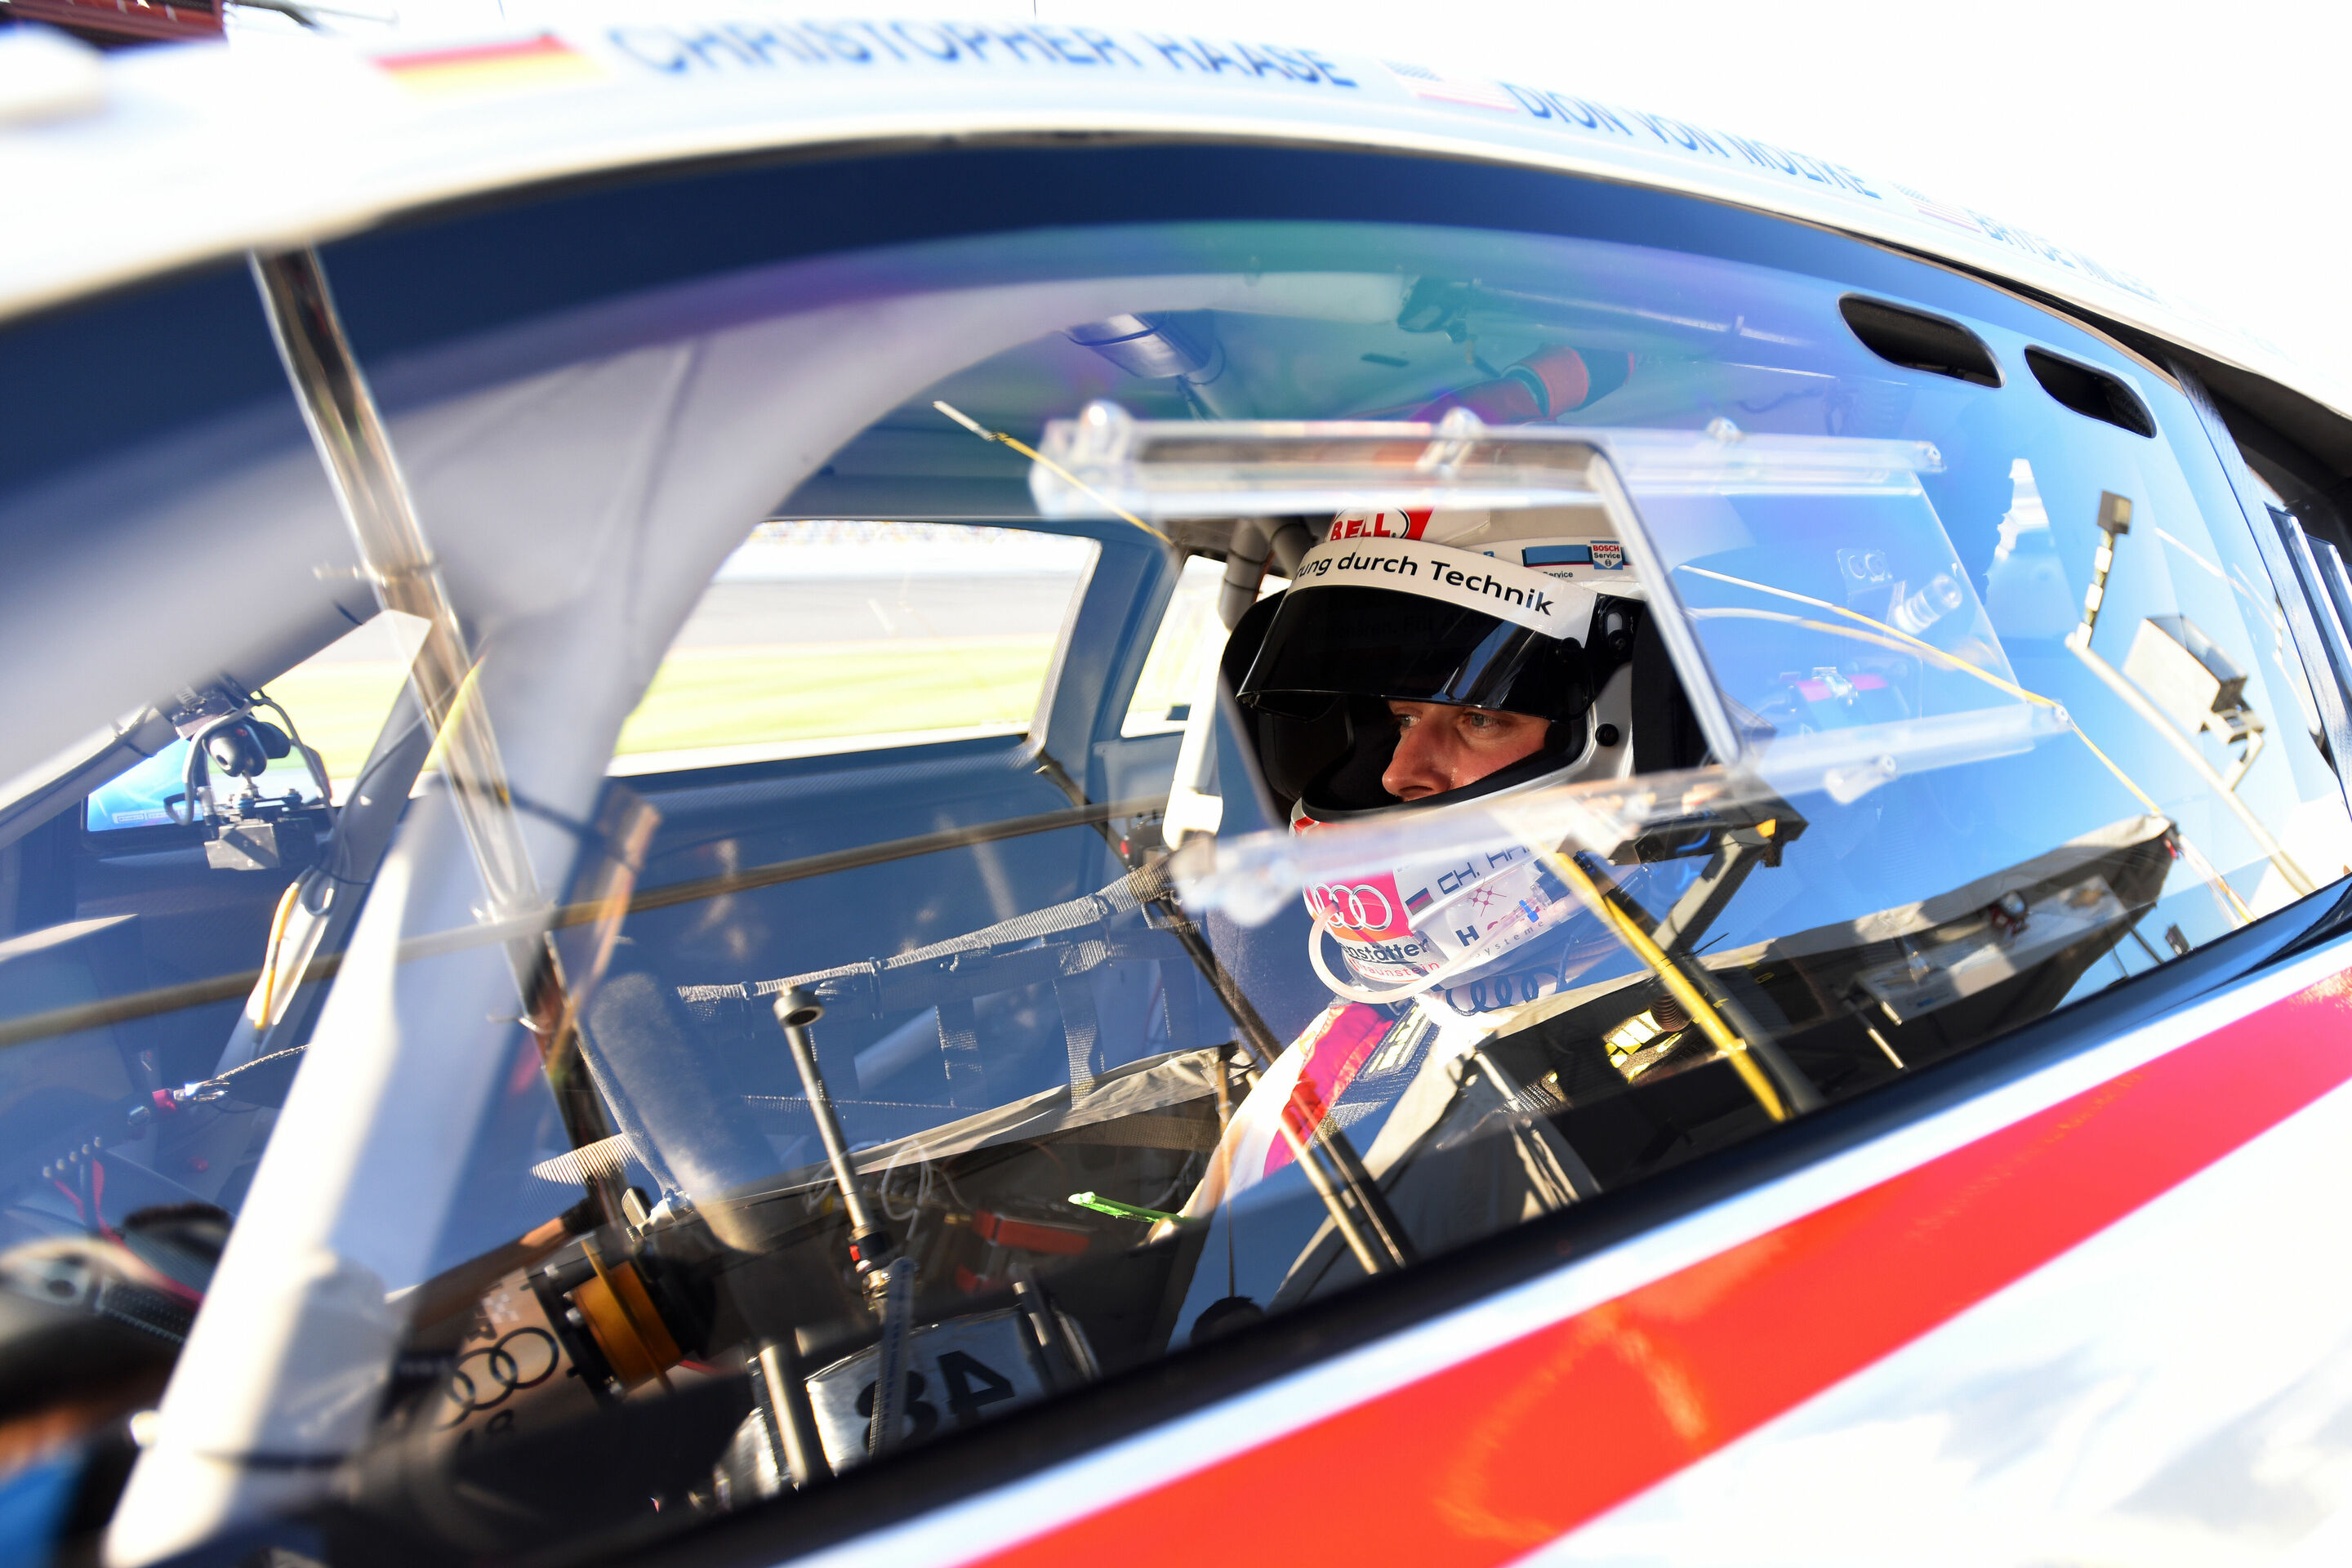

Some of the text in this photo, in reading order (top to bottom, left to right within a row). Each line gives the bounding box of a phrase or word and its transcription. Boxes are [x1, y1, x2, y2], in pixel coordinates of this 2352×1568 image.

[603, 20, 1359, 86] CHRISTOPHER HAASE
[1499, 80, 1633, 136] DION
[1619, 105, 1732, 158] VON
[1330, 513, 1392, 541] BELL
[1337, 551, 1419, 577] durch
[1430, 560, 1555, 617] Technik
